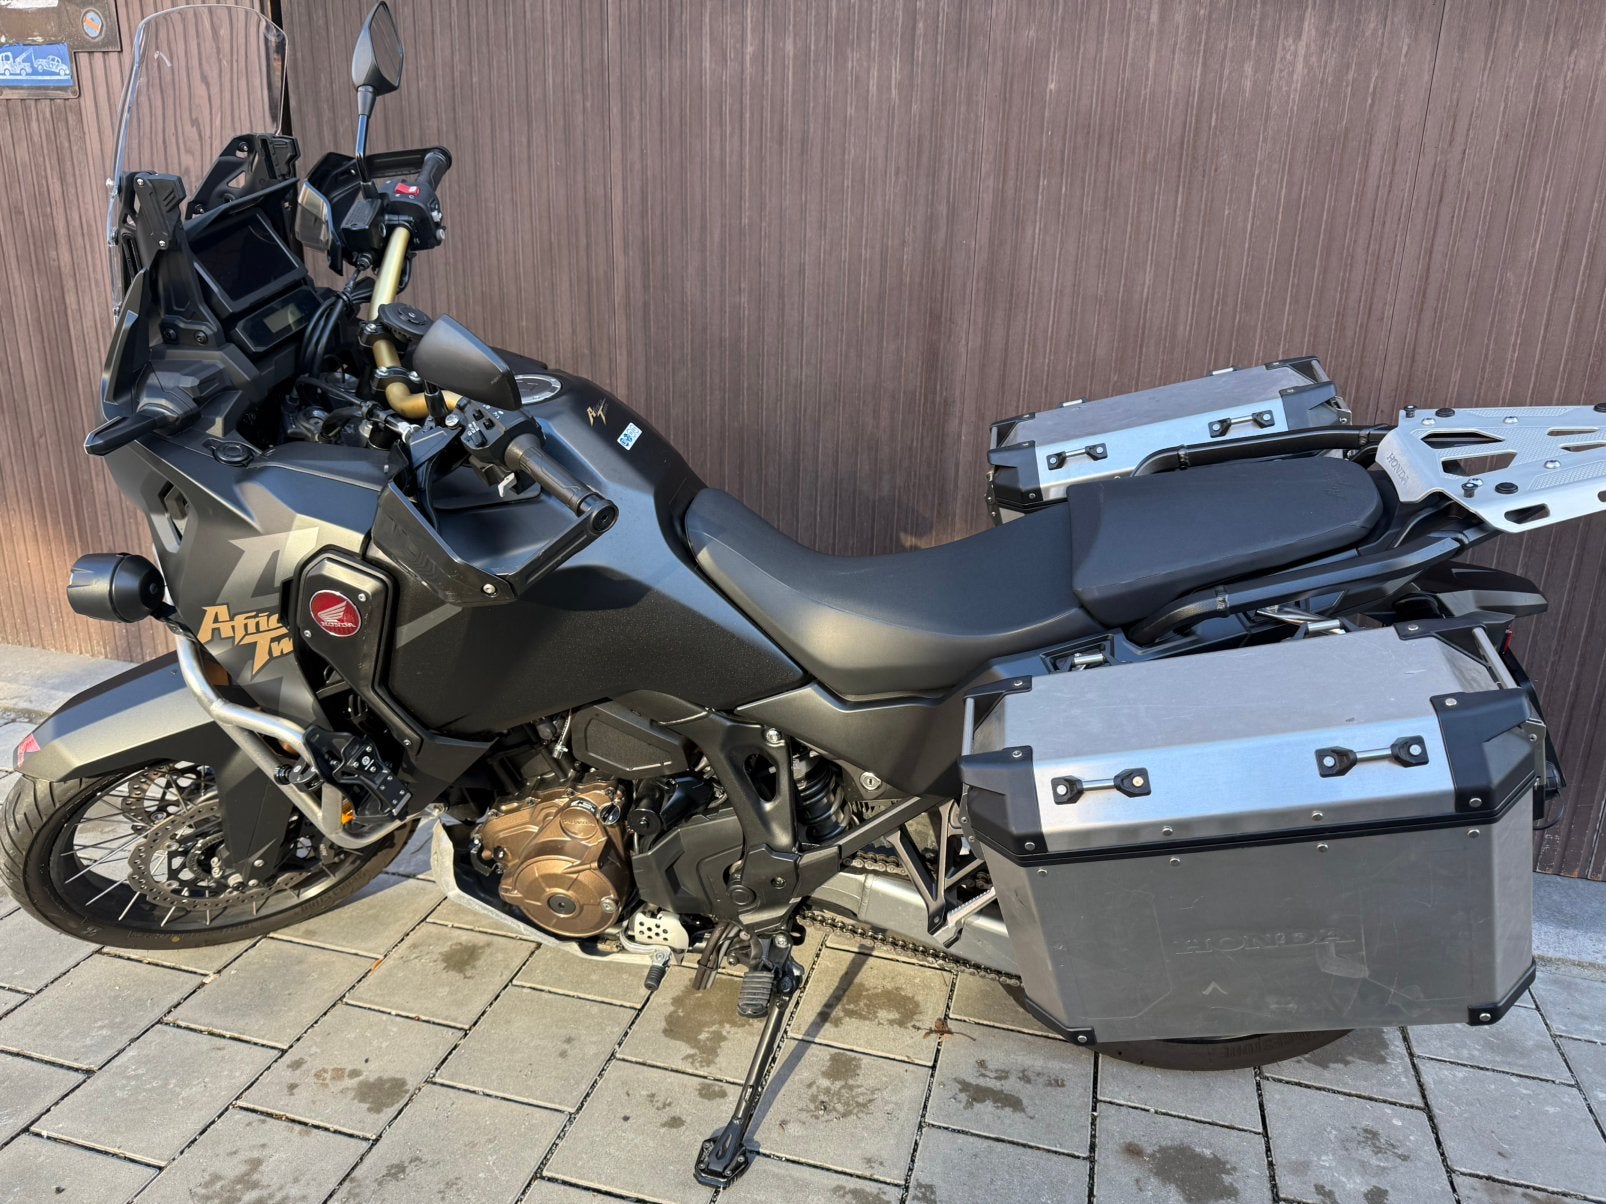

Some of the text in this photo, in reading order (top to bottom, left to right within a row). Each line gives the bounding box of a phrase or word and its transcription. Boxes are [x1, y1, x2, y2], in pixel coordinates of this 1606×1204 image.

[1386, 452, 1409, 486] HONDA
[197, 604, 286, 645] Afric
[320, 620, 357, 628] HONDA
